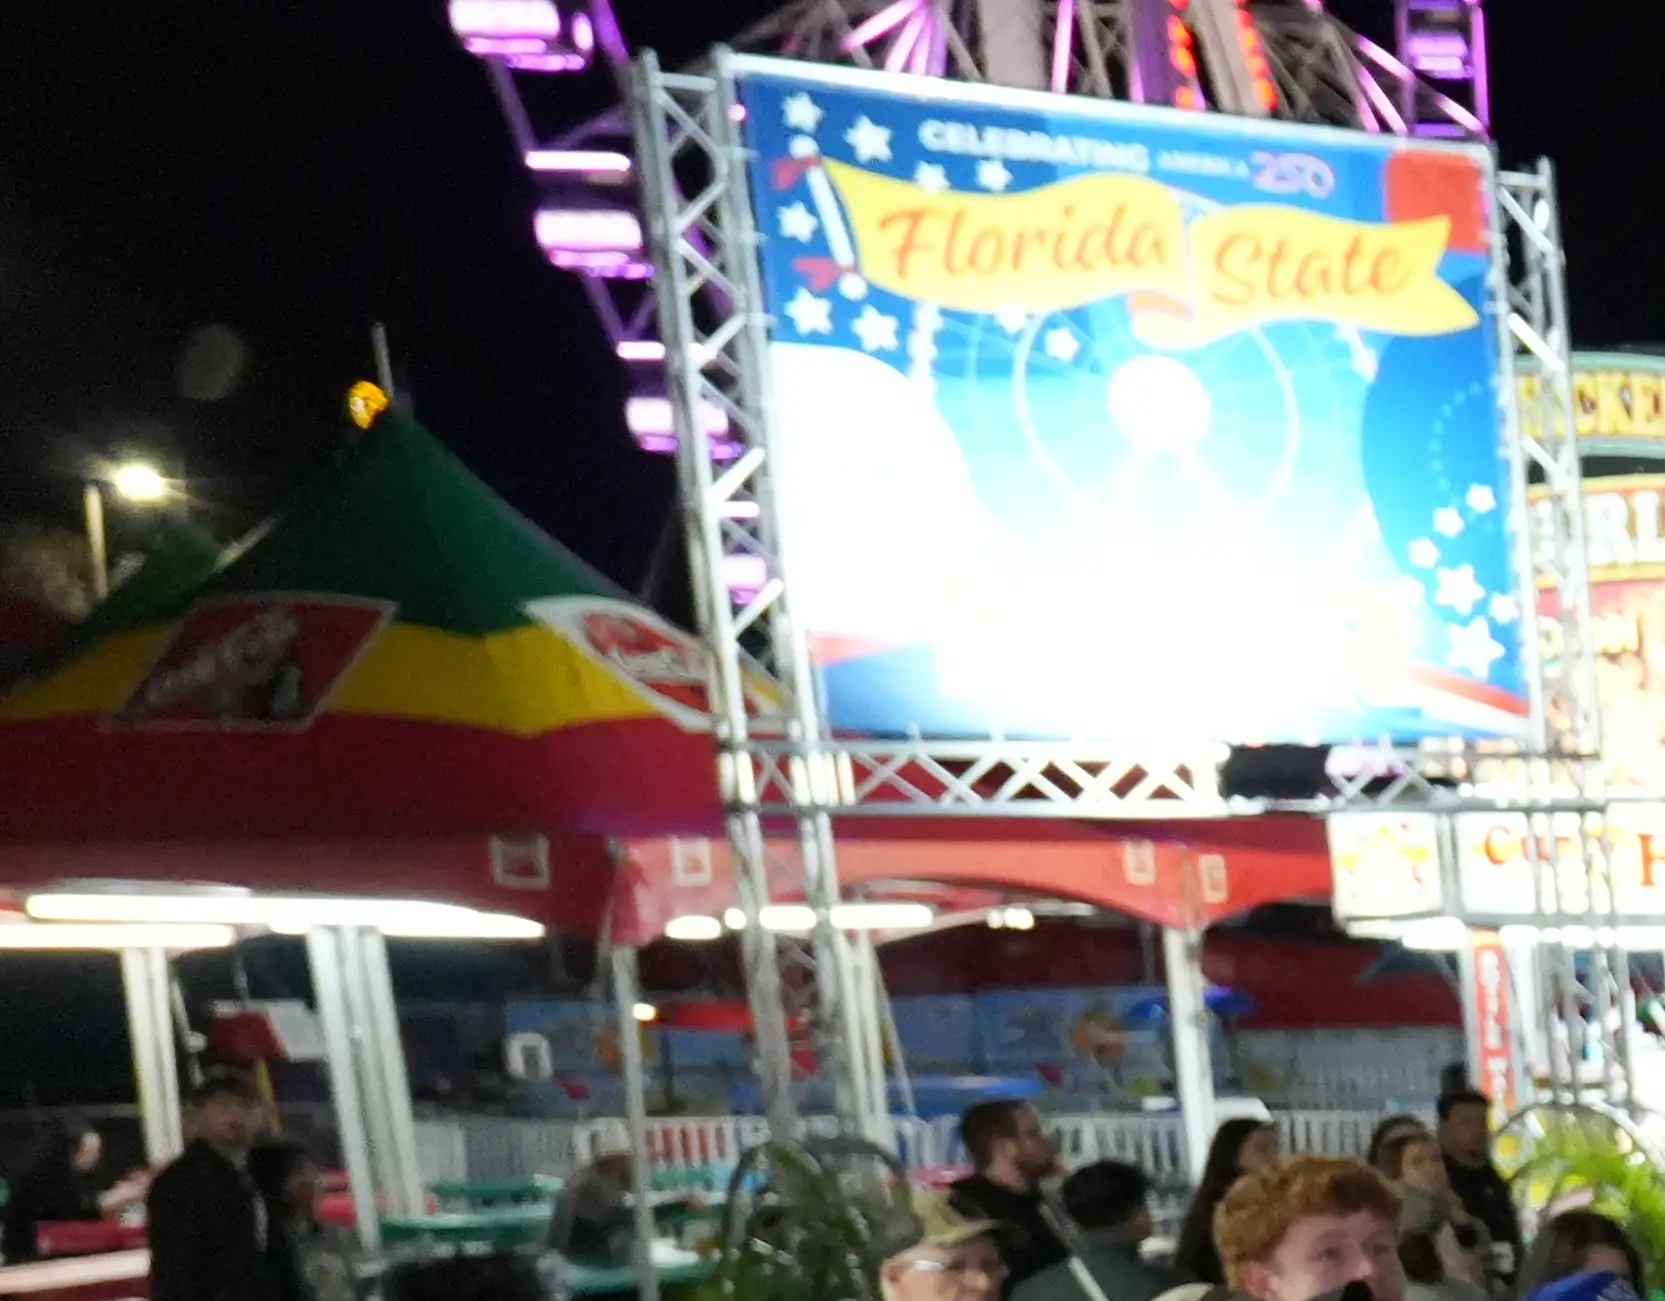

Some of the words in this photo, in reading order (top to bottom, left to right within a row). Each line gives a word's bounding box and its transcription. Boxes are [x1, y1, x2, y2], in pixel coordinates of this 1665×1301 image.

[920, 118, 1151, 171] CELEBRATING
[1250, 150, 1335, 199] 250
[878, 203, 1166, 281] Florida
[1210, 224, 1413, 306] State
